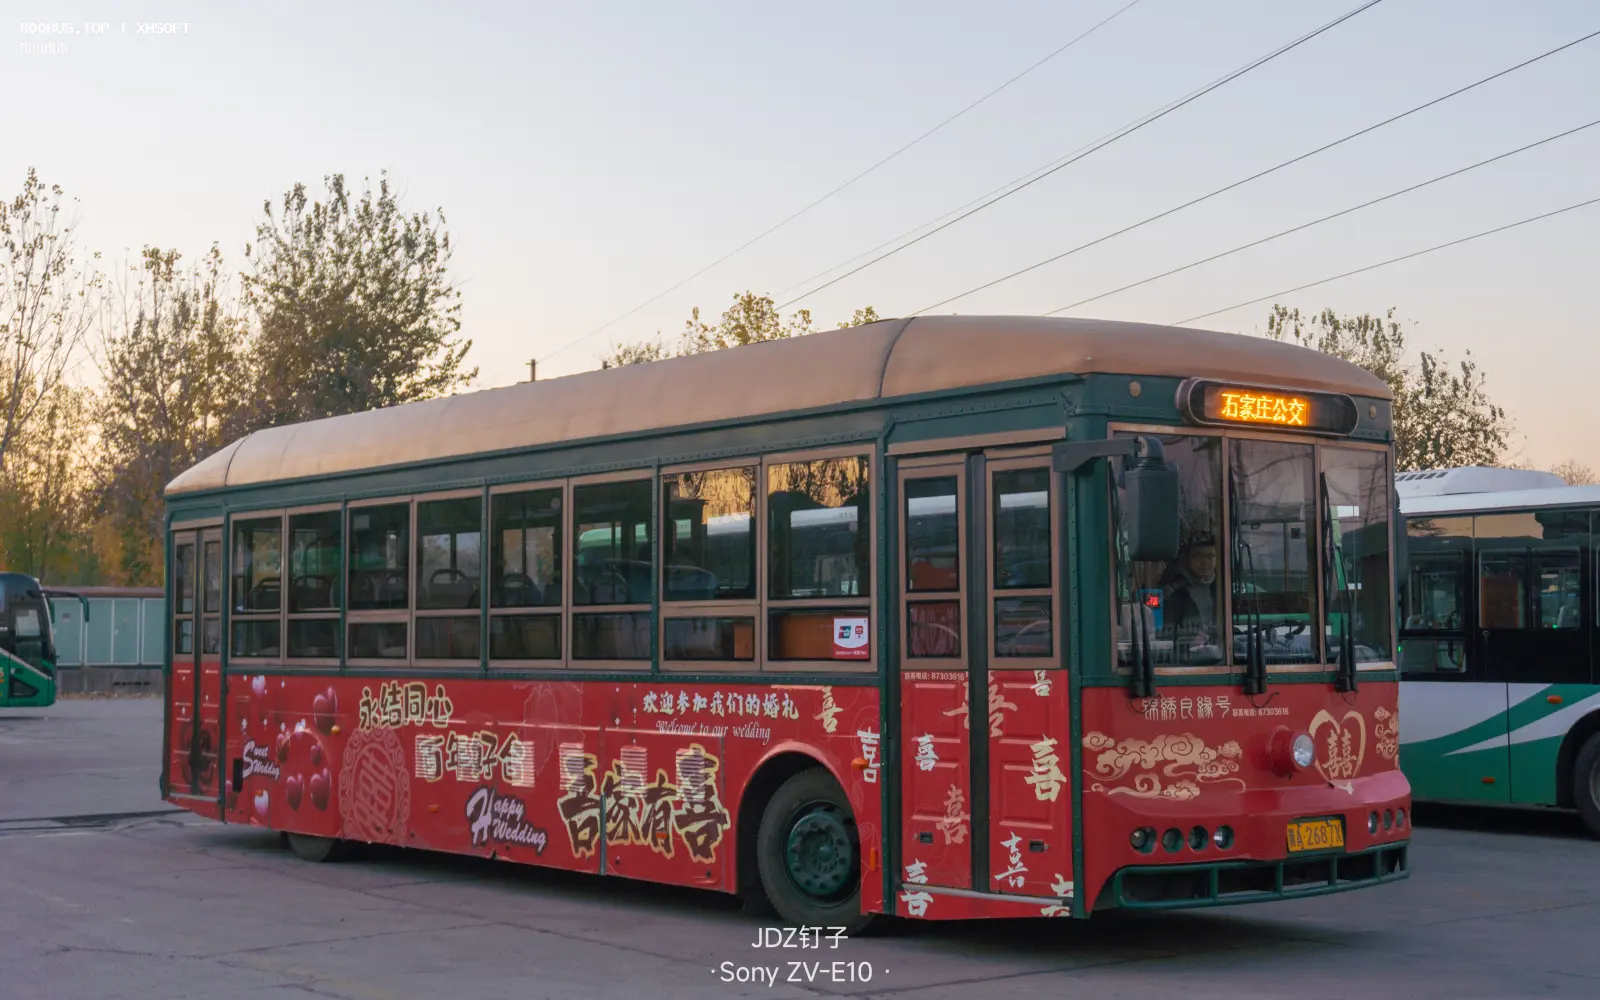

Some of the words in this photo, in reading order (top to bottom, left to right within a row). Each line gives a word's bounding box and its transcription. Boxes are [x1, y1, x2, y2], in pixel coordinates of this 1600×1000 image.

[1221, 393, 1305, 425] 石家庄公交
[359, 680, 454, 732] 永结同心
[642, 690, 799, 720] 欢迎参加我们的婚礼
[656, 718, 696, 736] Welcome
[699, 722, 710, 737] to
[711, 725, 729, 738] our
[732, 721, 771, 746] wedding
[416, 730, 526, 784] 百年好合
[1024, 733, 1067, 803] 喜
[466, 787, 525, 845] Happy
[492, 818, 546, 853] Wedding
